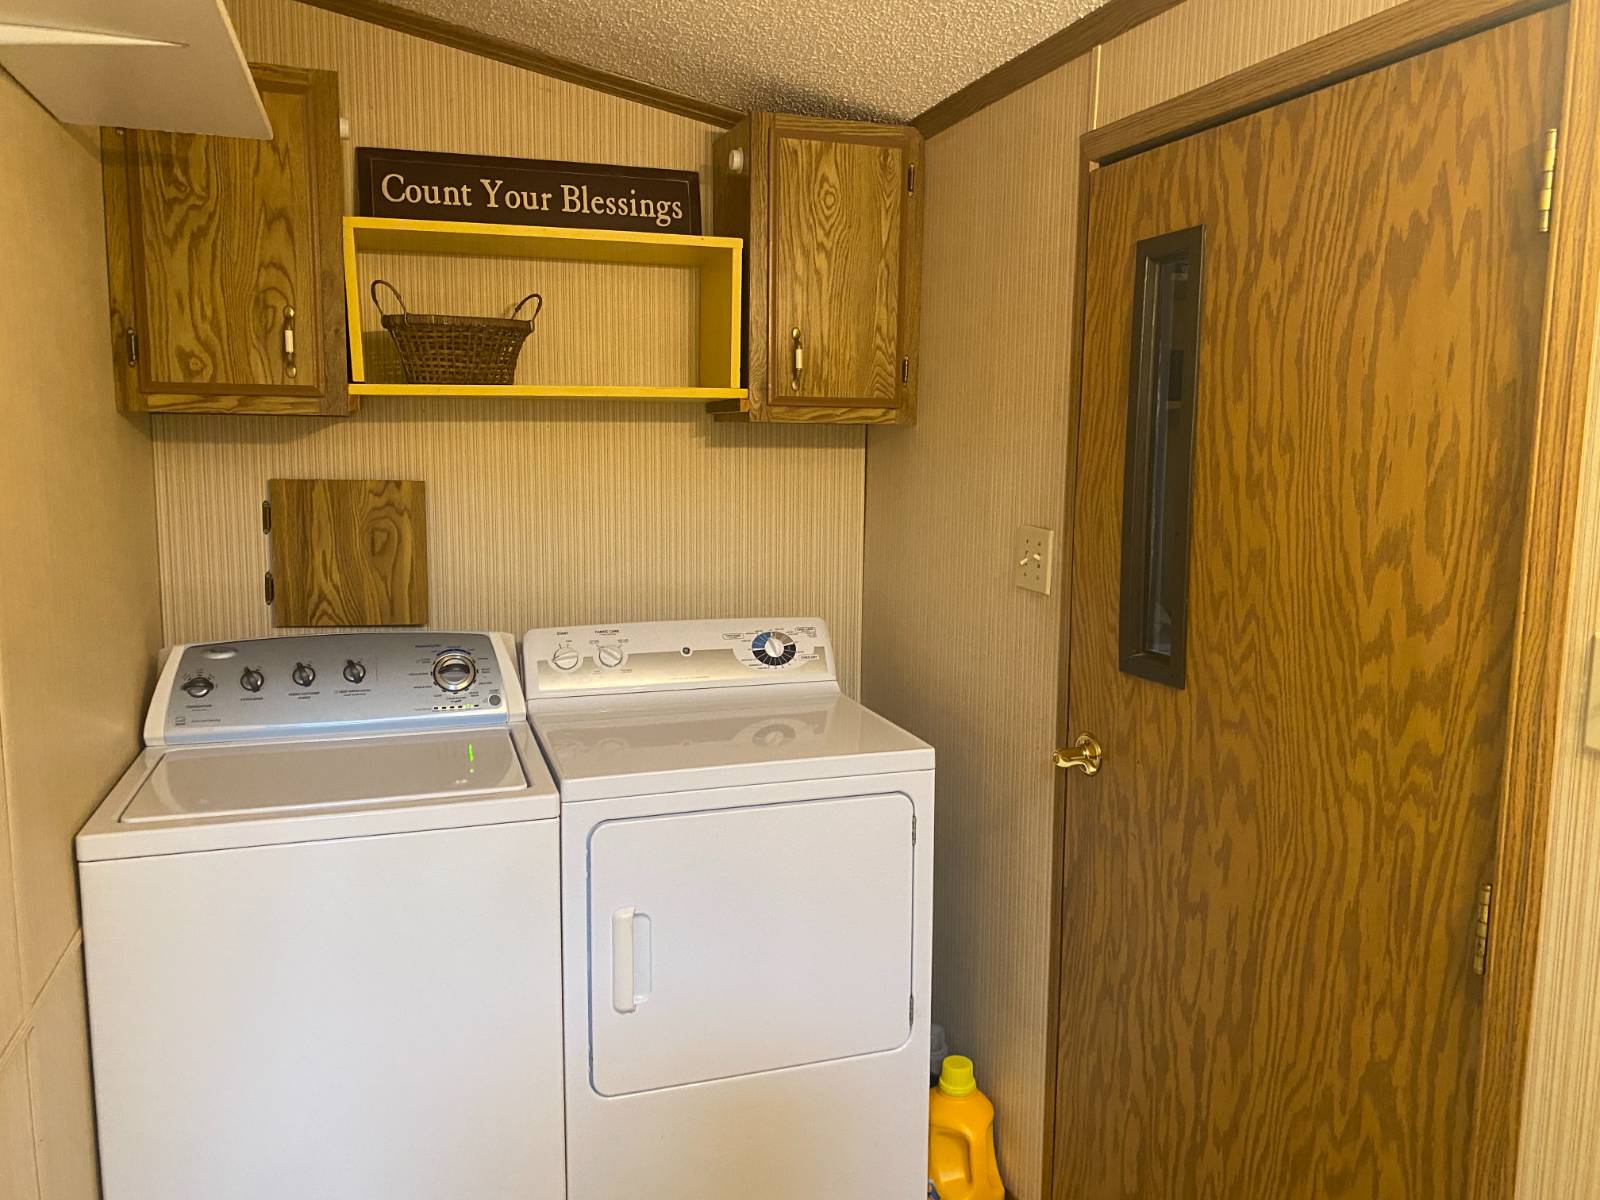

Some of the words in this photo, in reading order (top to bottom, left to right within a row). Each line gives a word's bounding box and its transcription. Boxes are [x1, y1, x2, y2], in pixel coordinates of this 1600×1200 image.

[381, 173, 472, 207] Count
[480, 178, 553, 211] Your
[561, 184, 683, 227] Blessings
